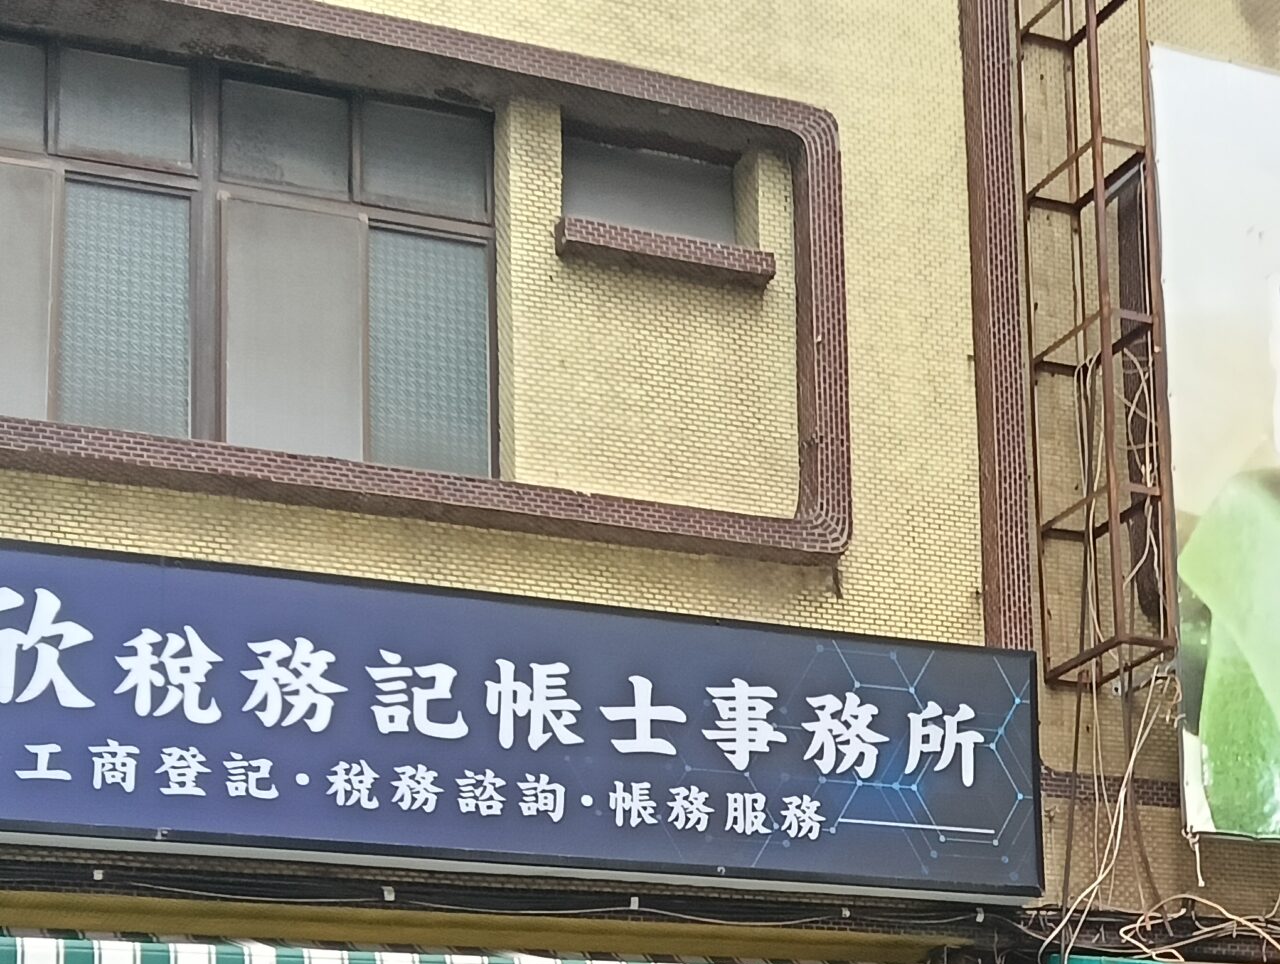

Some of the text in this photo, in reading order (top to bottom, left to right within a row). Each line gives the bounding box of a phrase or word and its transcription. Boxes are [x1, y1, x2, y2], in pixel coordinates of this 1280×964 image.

[0, 586, 984, 788] 欣稅務記帳士事務所
